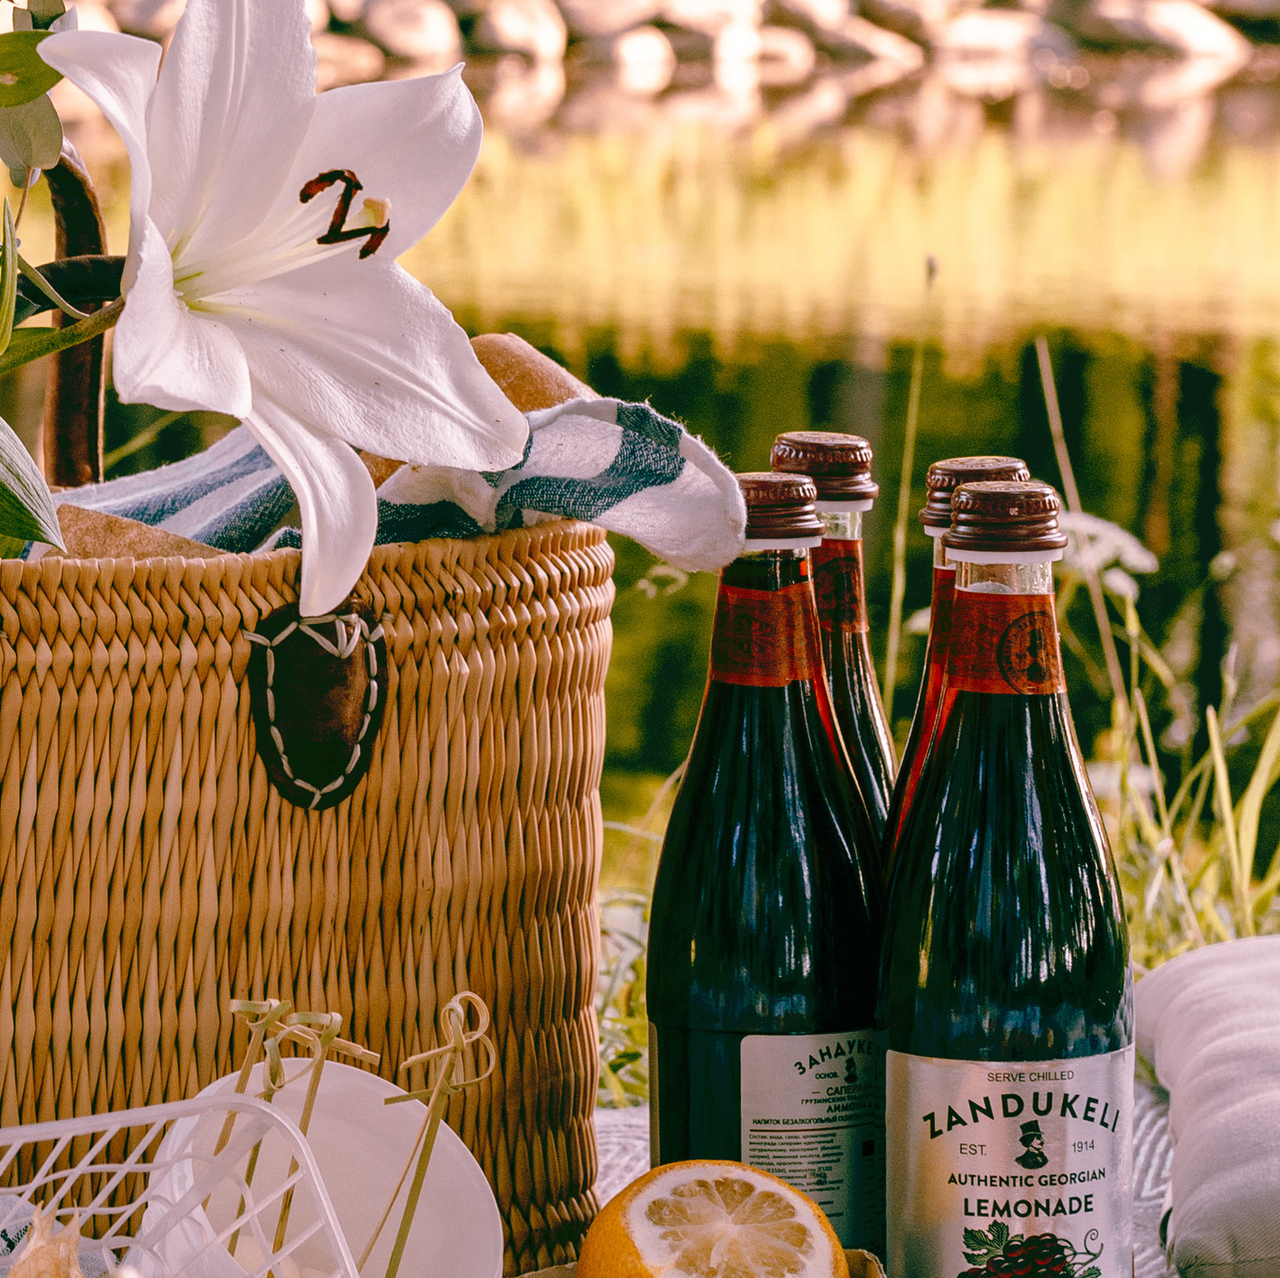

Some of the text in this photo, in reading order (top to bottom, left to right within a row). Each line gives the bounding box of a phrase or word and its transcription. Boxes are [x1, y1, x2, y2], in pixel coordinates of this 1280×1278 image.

[794, 1039, 875, 1075] ЗАНДУКЕ
[987, 1070, 1074, 1082] SERVE CHILLED
[923, 1091, 1119, 1140] ZANDUKELI
[959, 1143, 987, 1156] EST.
[1072, 1139, 1095, 1153] 1914
[947, 1167, 1106, 1188] AUTHENTIC GEORGIAN
[963, 1193, 1094, 1218] LEMONADE
